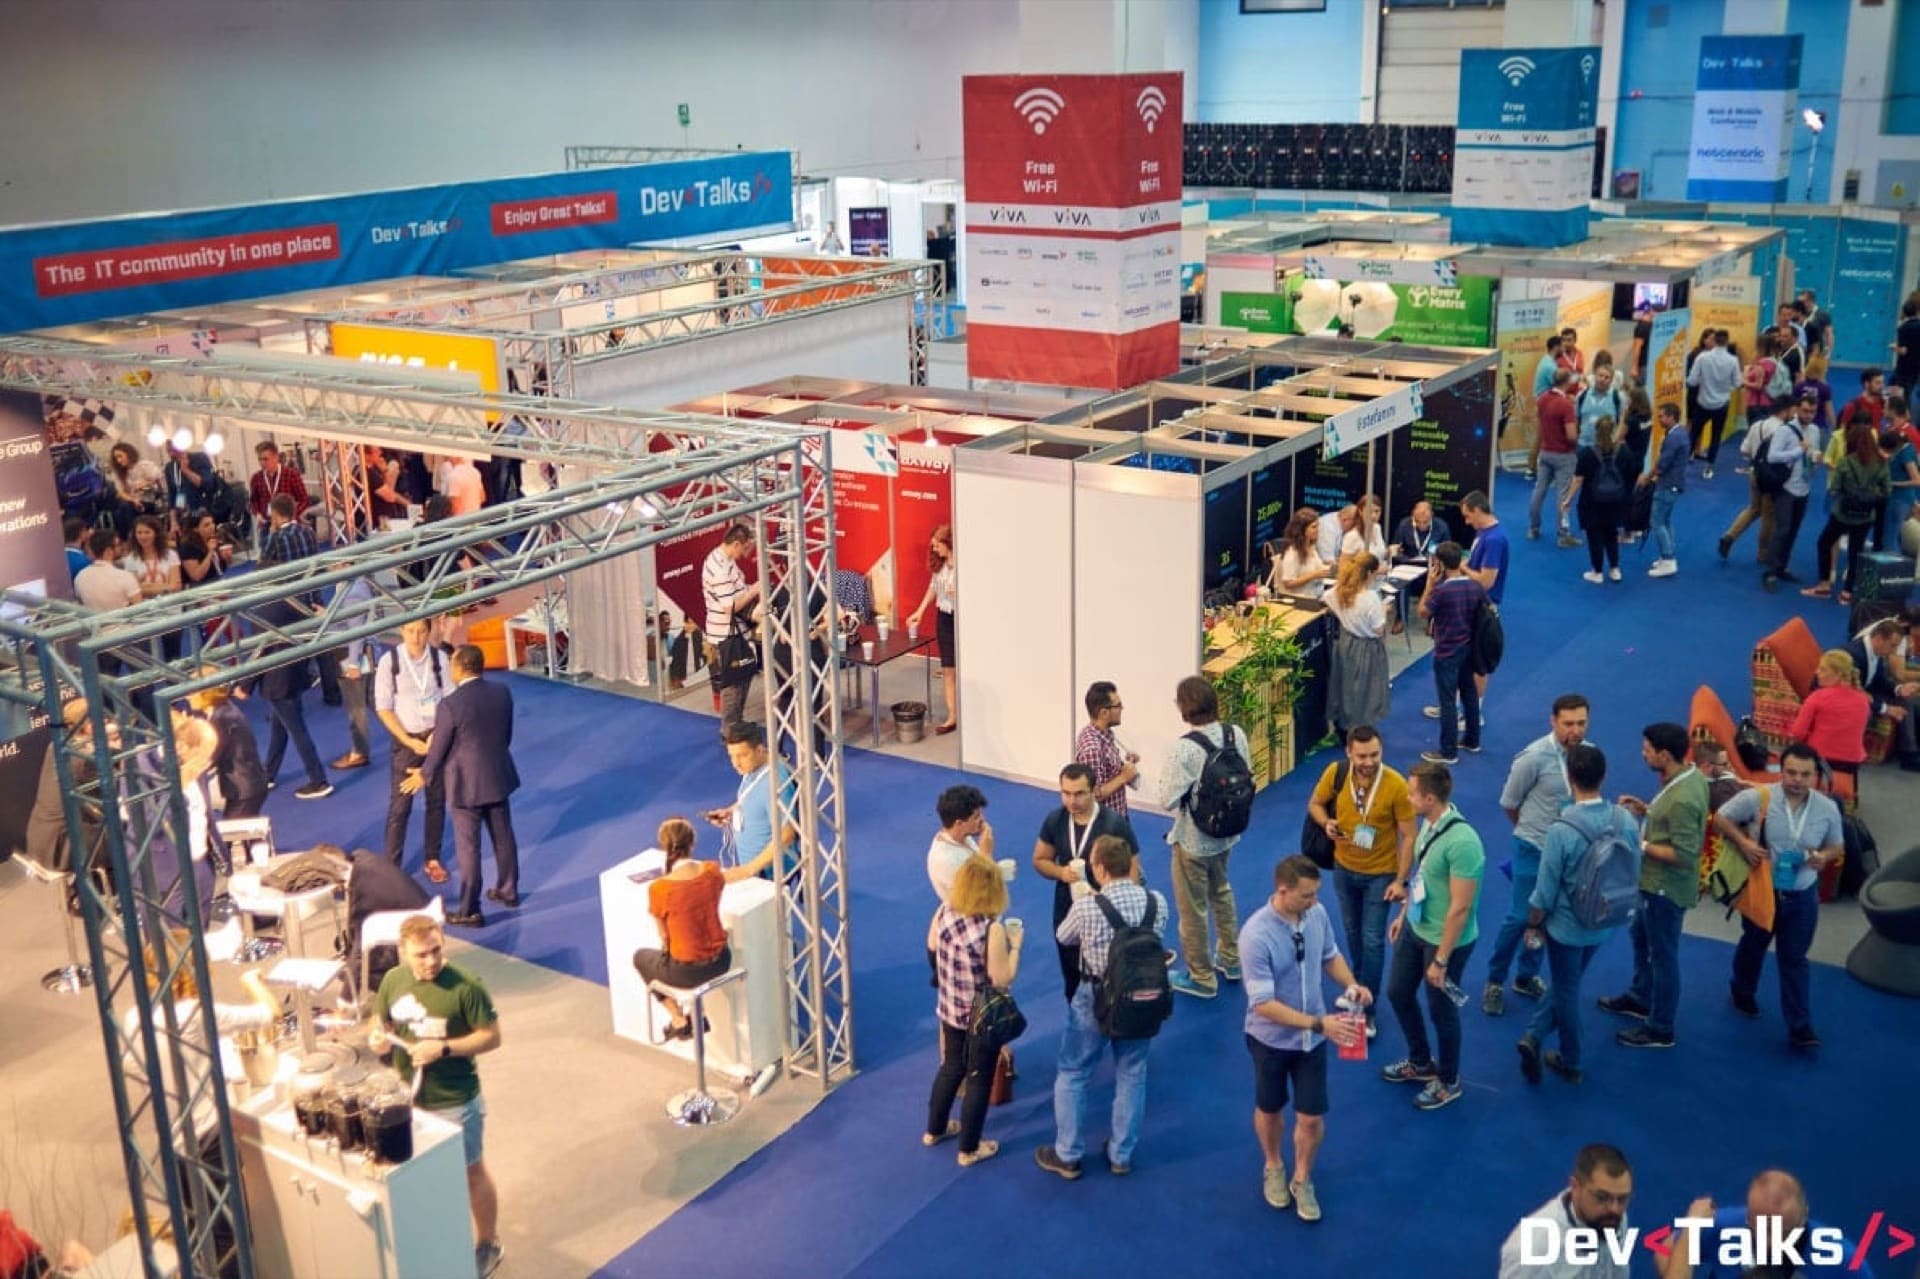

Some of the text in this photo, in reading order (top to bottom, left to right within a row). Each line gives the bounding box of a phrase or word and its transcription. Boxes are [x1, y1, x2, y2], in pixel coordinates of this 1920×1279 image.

[1025, 160, 1055, 175] Free
[1023, 179, 1058, 194] Wi-Fi
[504, 200, 607, 226] Enjoy Great Talks!
[46, 234, 333, 285] The IT community in one place
[1431, 285, 1463, 299] Every
[6, 440, 44, 457] Group
